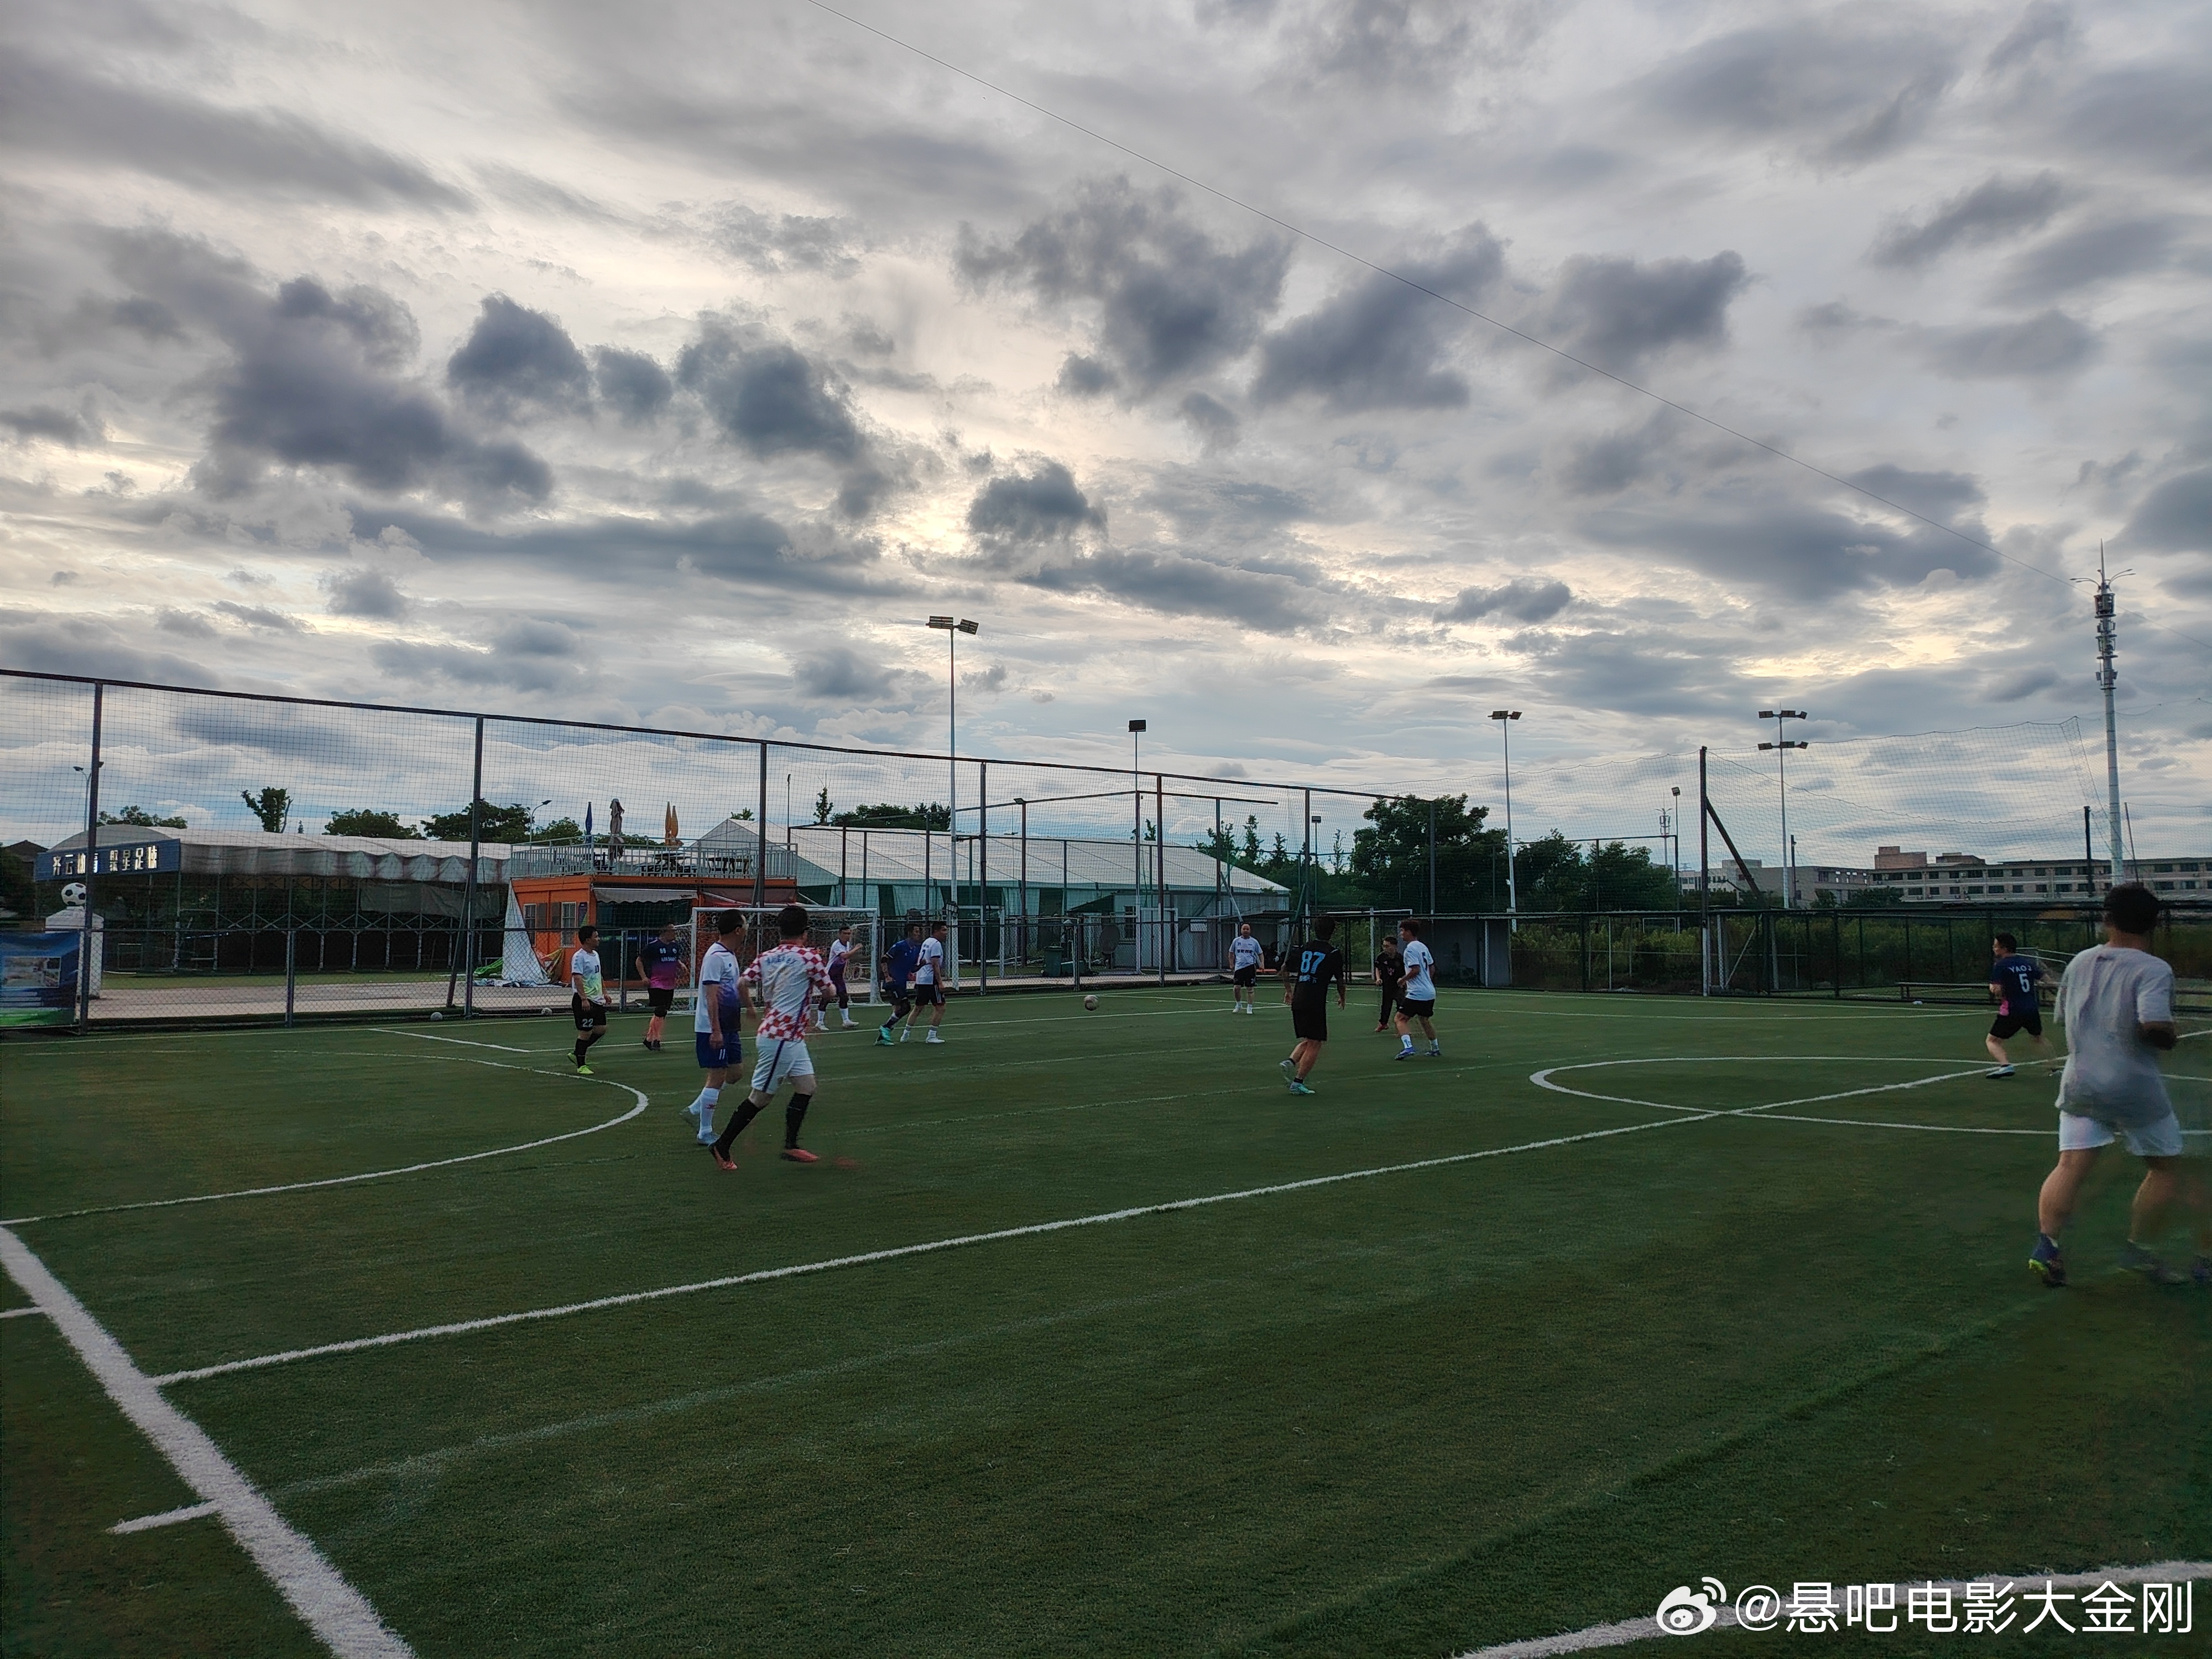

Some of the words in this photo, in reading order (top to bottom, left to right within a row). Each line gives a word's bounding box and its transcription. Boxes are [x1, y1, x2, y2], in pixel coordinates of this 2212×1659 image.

[1301, 951, 1326, 974] 87
[2019, 973, 2030, 993] 5
[582, 1018, 593, 1027] 22
[719, 1048, 726, 1060] 11
